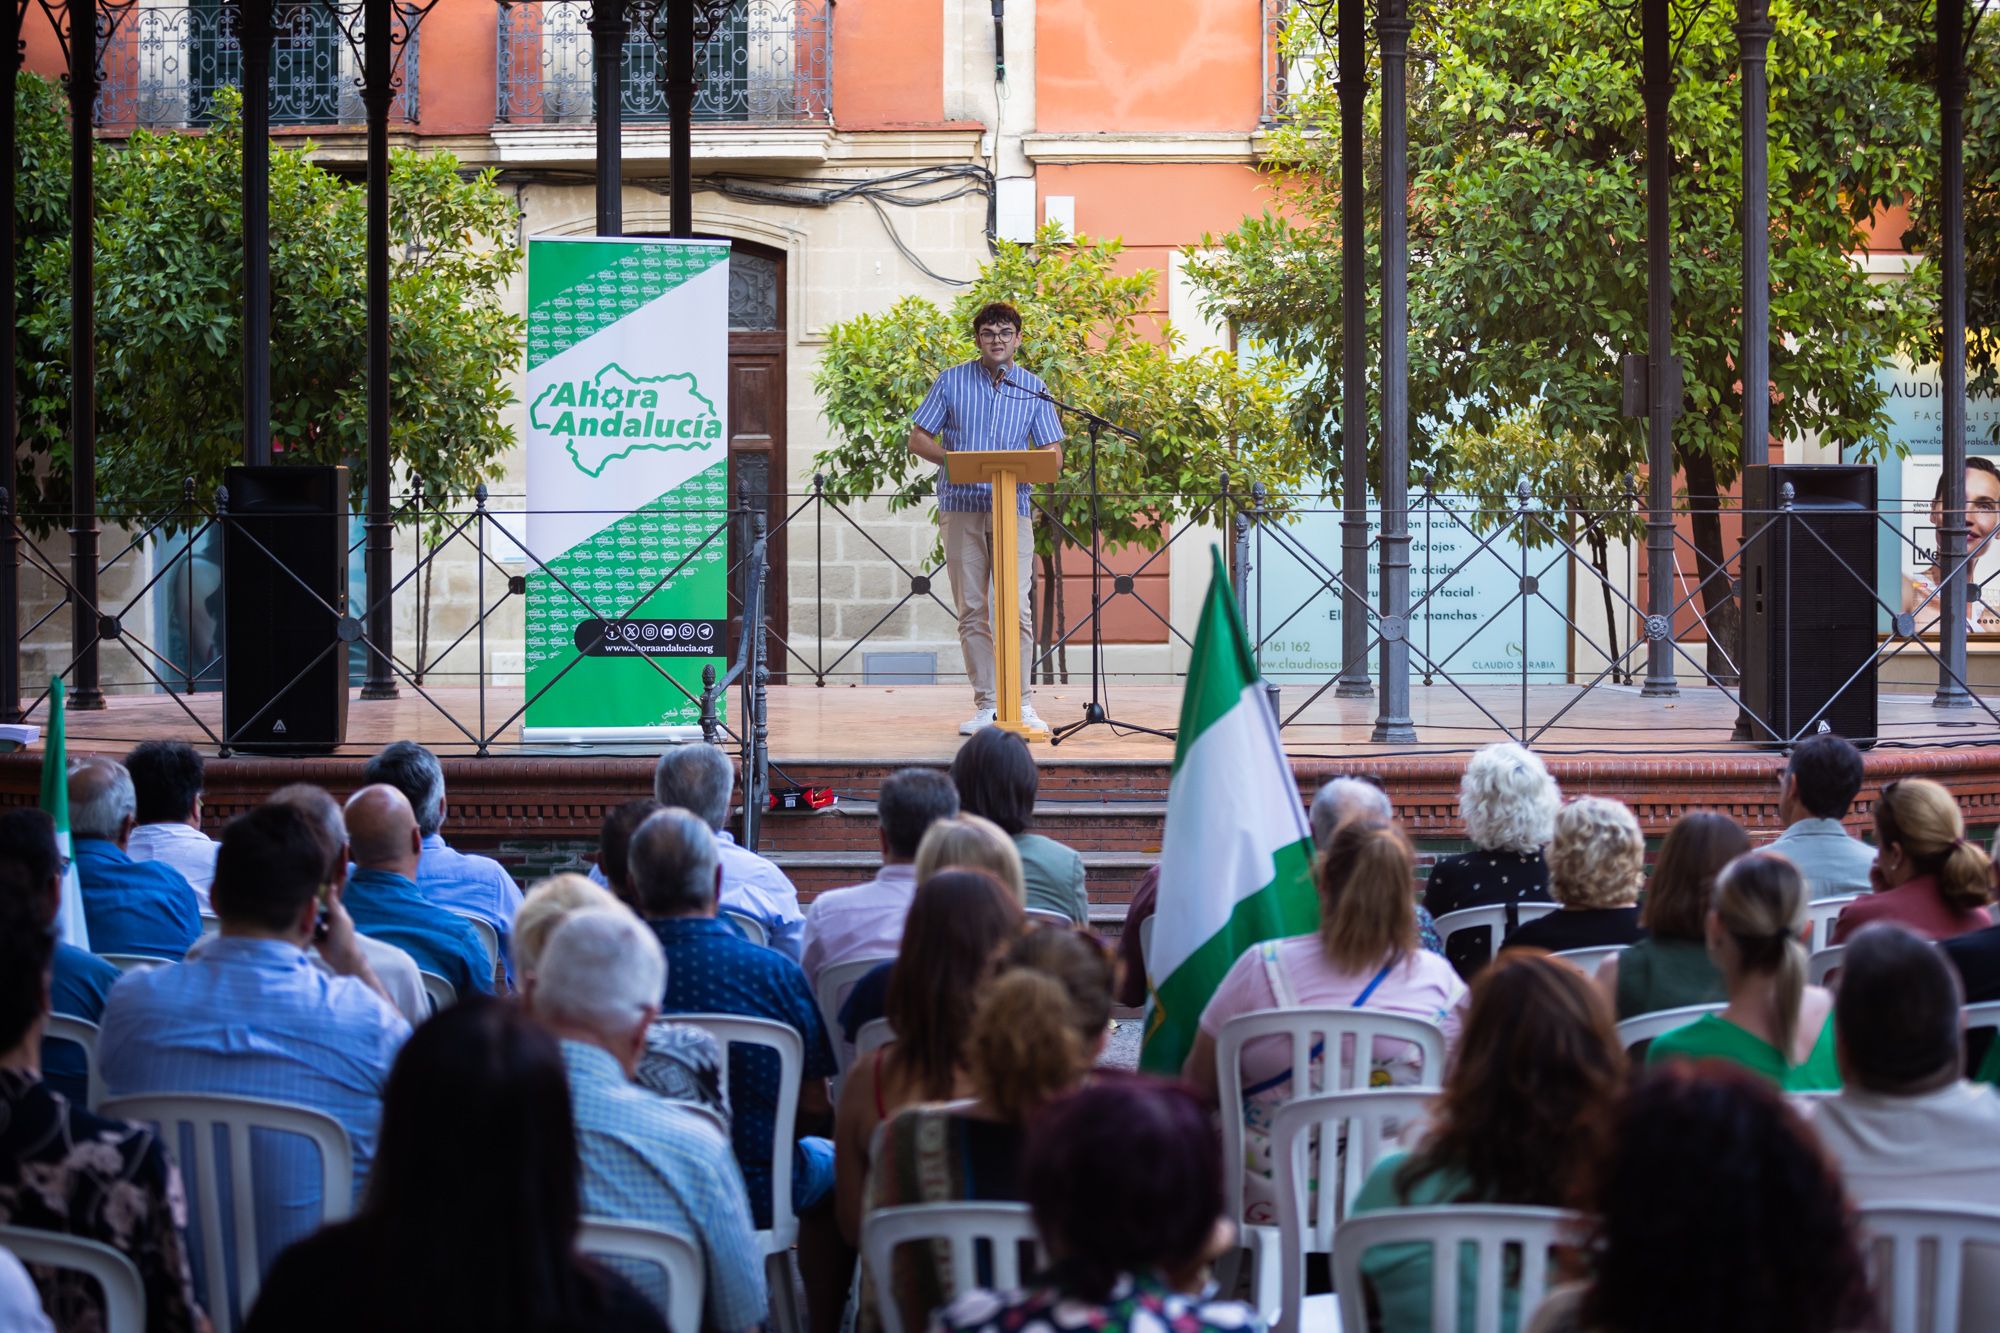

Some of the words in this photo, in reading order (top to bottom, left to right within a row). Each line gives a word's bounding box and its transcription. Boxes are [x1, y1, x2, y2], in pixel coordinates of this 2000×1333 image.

[549, 381, 658, 410] Ahora
[549, 410, 723, 439] Andalucía
[1412, 540, 1427, 551] de
[1431, 542, 1455, 553] ojos
[1440, 586, 1474, 597] facial
[1424, 609, 1478, 620] manchas
[1269, 641, 1286, 652] 161
[1291, 641, 1310, 652] 162
[1472, 661, 1514, 670] CLAUDIO
[1517, 661, 1556, 670] SRABIA
